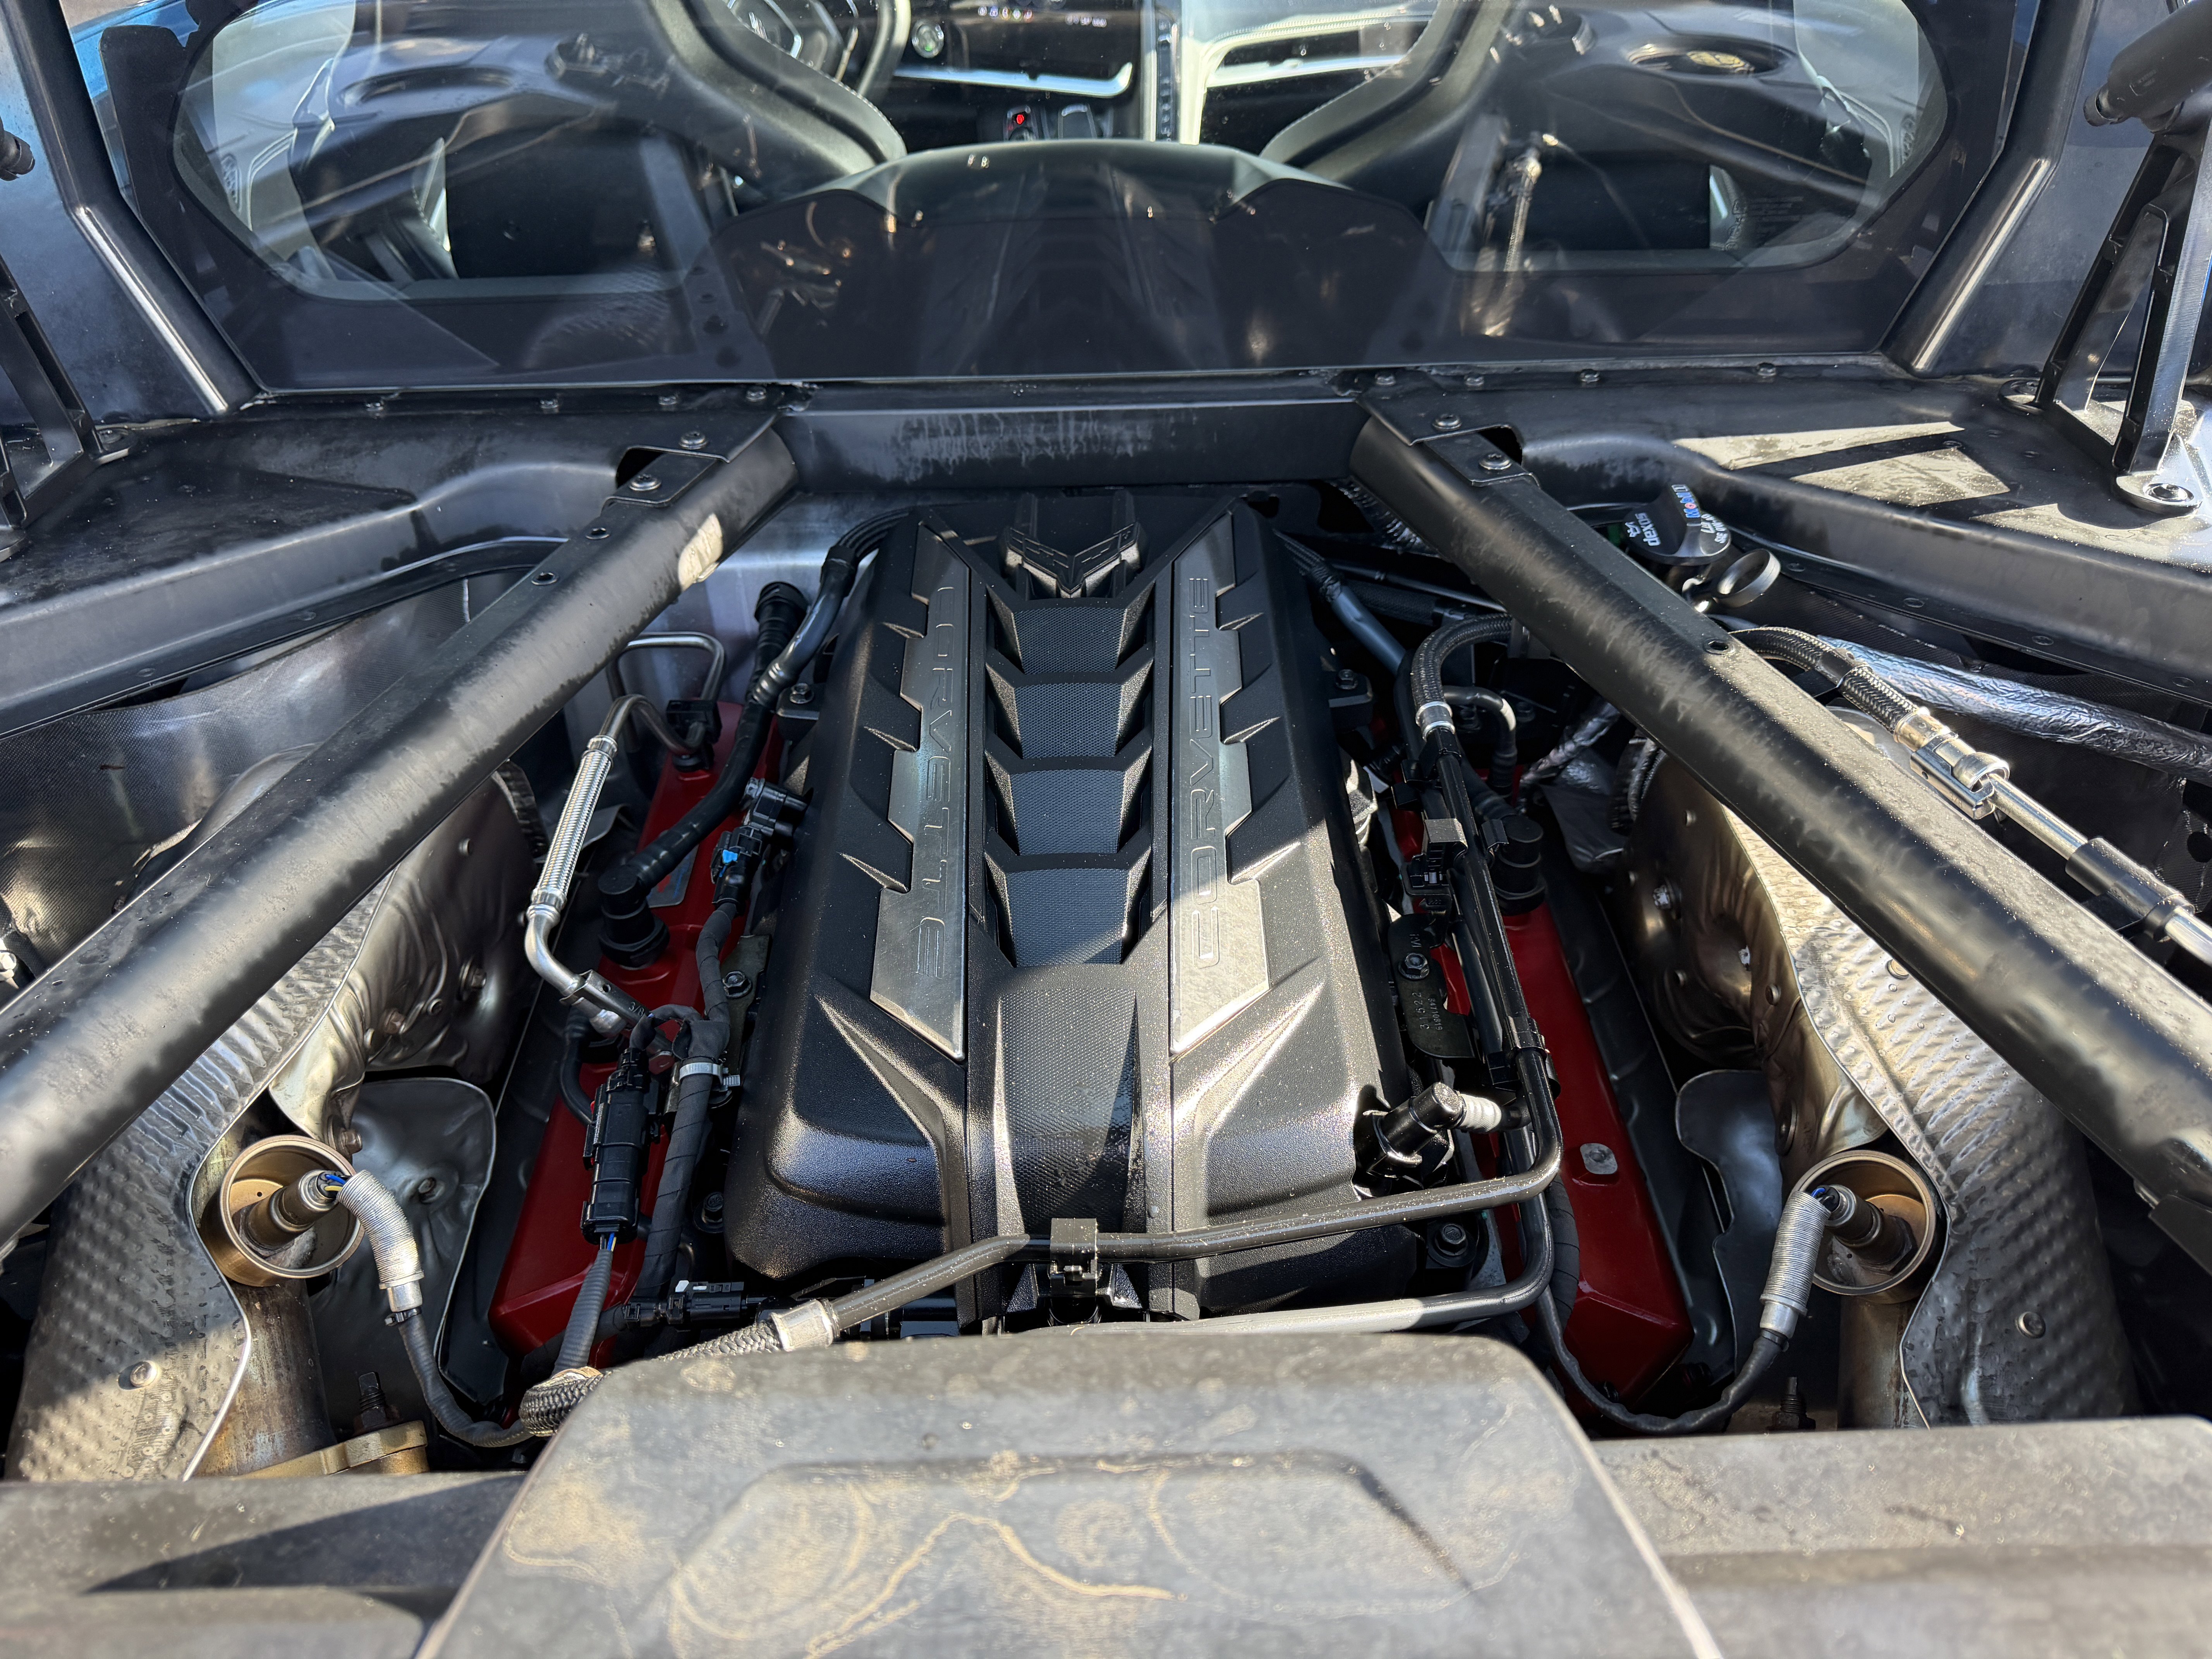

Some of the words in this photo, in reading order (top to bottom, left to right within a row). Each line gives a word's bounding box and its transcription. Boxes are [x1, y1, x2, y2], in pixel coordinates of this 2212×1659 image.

[1635, 512, 1661, 546] dexos
[917, 586, 954, 979] CORVETTE
[1189, 577, 1219, 970] CORVETTE
[629, 1001, 644, 1017] 3/8
[1412, 992, 1429, 1029] 31522
[1428, 998, 1443, 1030] 84710819
